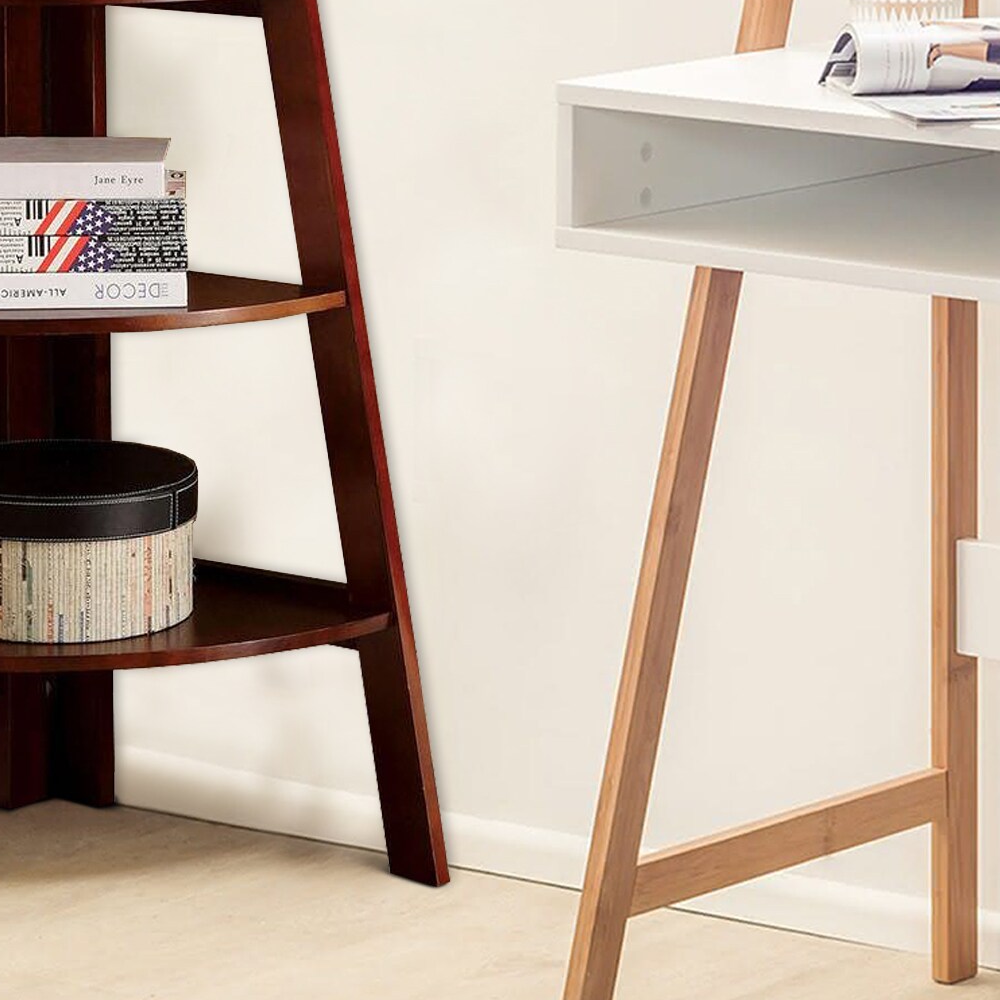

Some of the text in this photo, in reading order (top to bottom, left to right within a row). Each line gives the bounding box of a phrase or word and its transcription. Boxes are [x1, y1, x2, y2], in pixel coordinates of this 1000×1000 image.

[94, 175, 143, 186] Jane Eyre
[94, 283, 160, 299] DECOR
